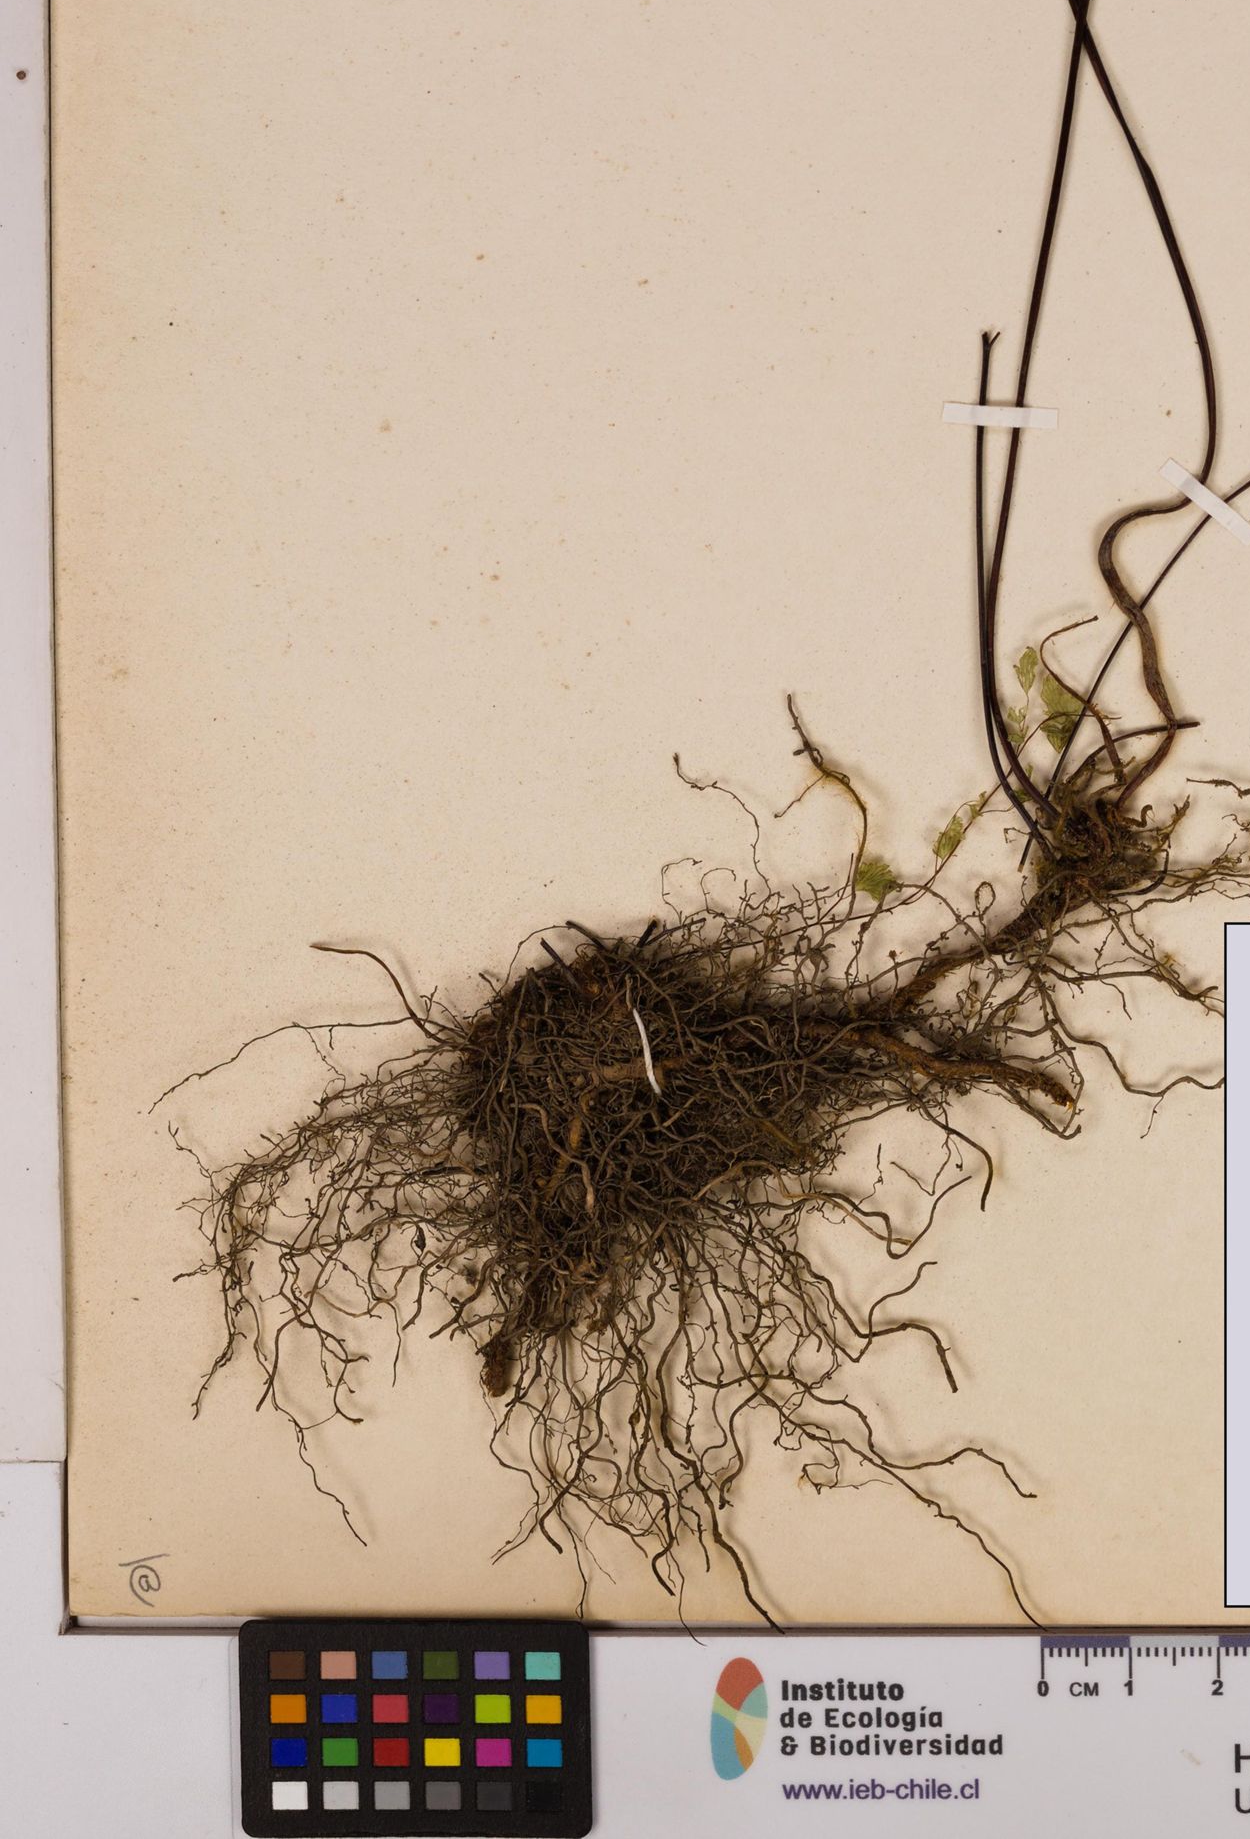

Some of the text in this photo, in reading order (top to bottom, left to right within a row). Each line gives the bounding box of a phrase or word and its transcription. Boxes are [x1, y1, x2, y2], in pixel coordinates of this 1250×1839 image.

[781, 1677, 905, 1702] Instituto
[1037, 1679, 1049, 1698] 0
[1068, 1681, 1100, 1698] CM
[1124, 1678, 1134, 1697] 1
[1211, 1678, 1224, 1697] 2
[779, 1705, 944, 1732] de Ecología
[780, 1733, 1004, 1757] & Biodiversidad
[781, 1778, 981, 1801] www.ieb-chile.cl
